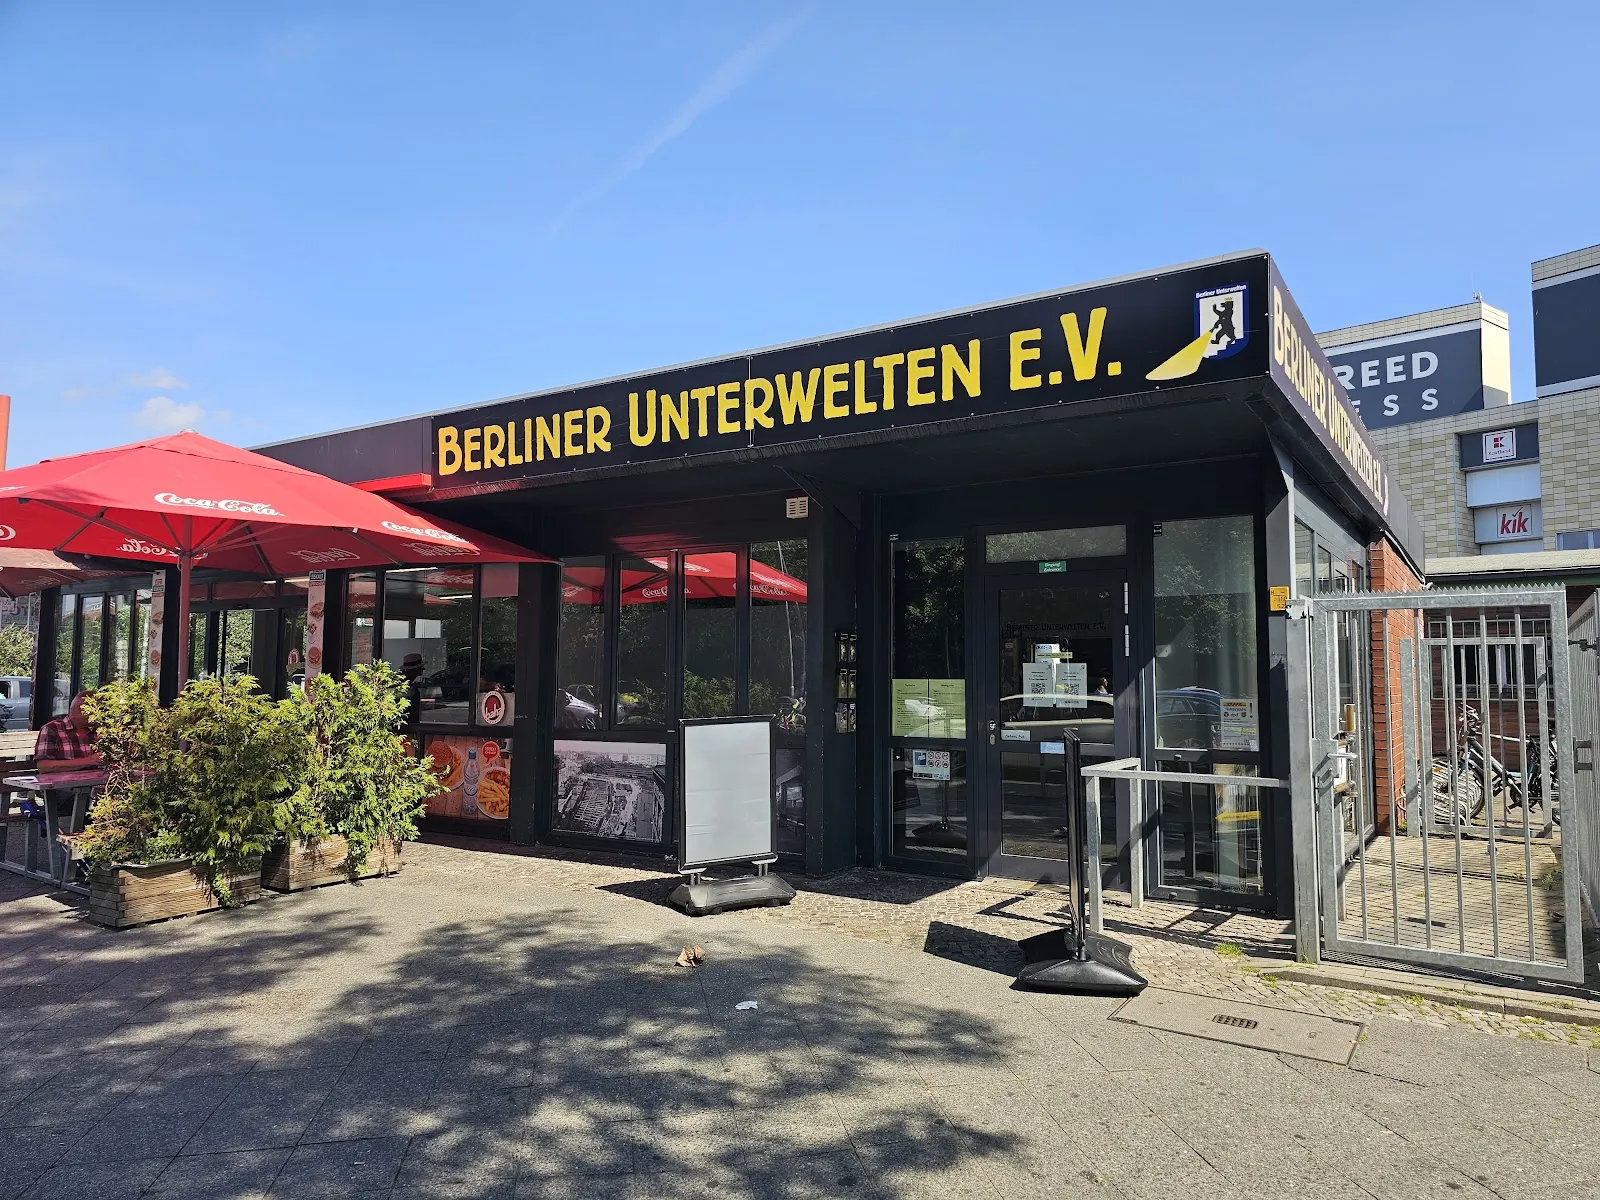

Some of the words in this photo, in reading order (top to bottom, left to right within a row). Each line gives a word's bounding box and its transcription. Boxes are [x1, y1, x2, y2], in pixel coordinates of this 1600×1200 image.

[1195, 290, 1215, 298] Berliner
[1216, 285, 1246, 295] Unterwelten
[1274, 285, 1327, 428] BERLINER
[438, 406, 611, 476] BERLINER
[628, 338, 981, 447] UNTERWELTEN
[1009, 307, 1122, 391] E.V.
[154, 492, 285, 517] Coca-Cola
[381, 520, 470, 544] Coca-Cola
[1500, 507, 1529, 535] kik
